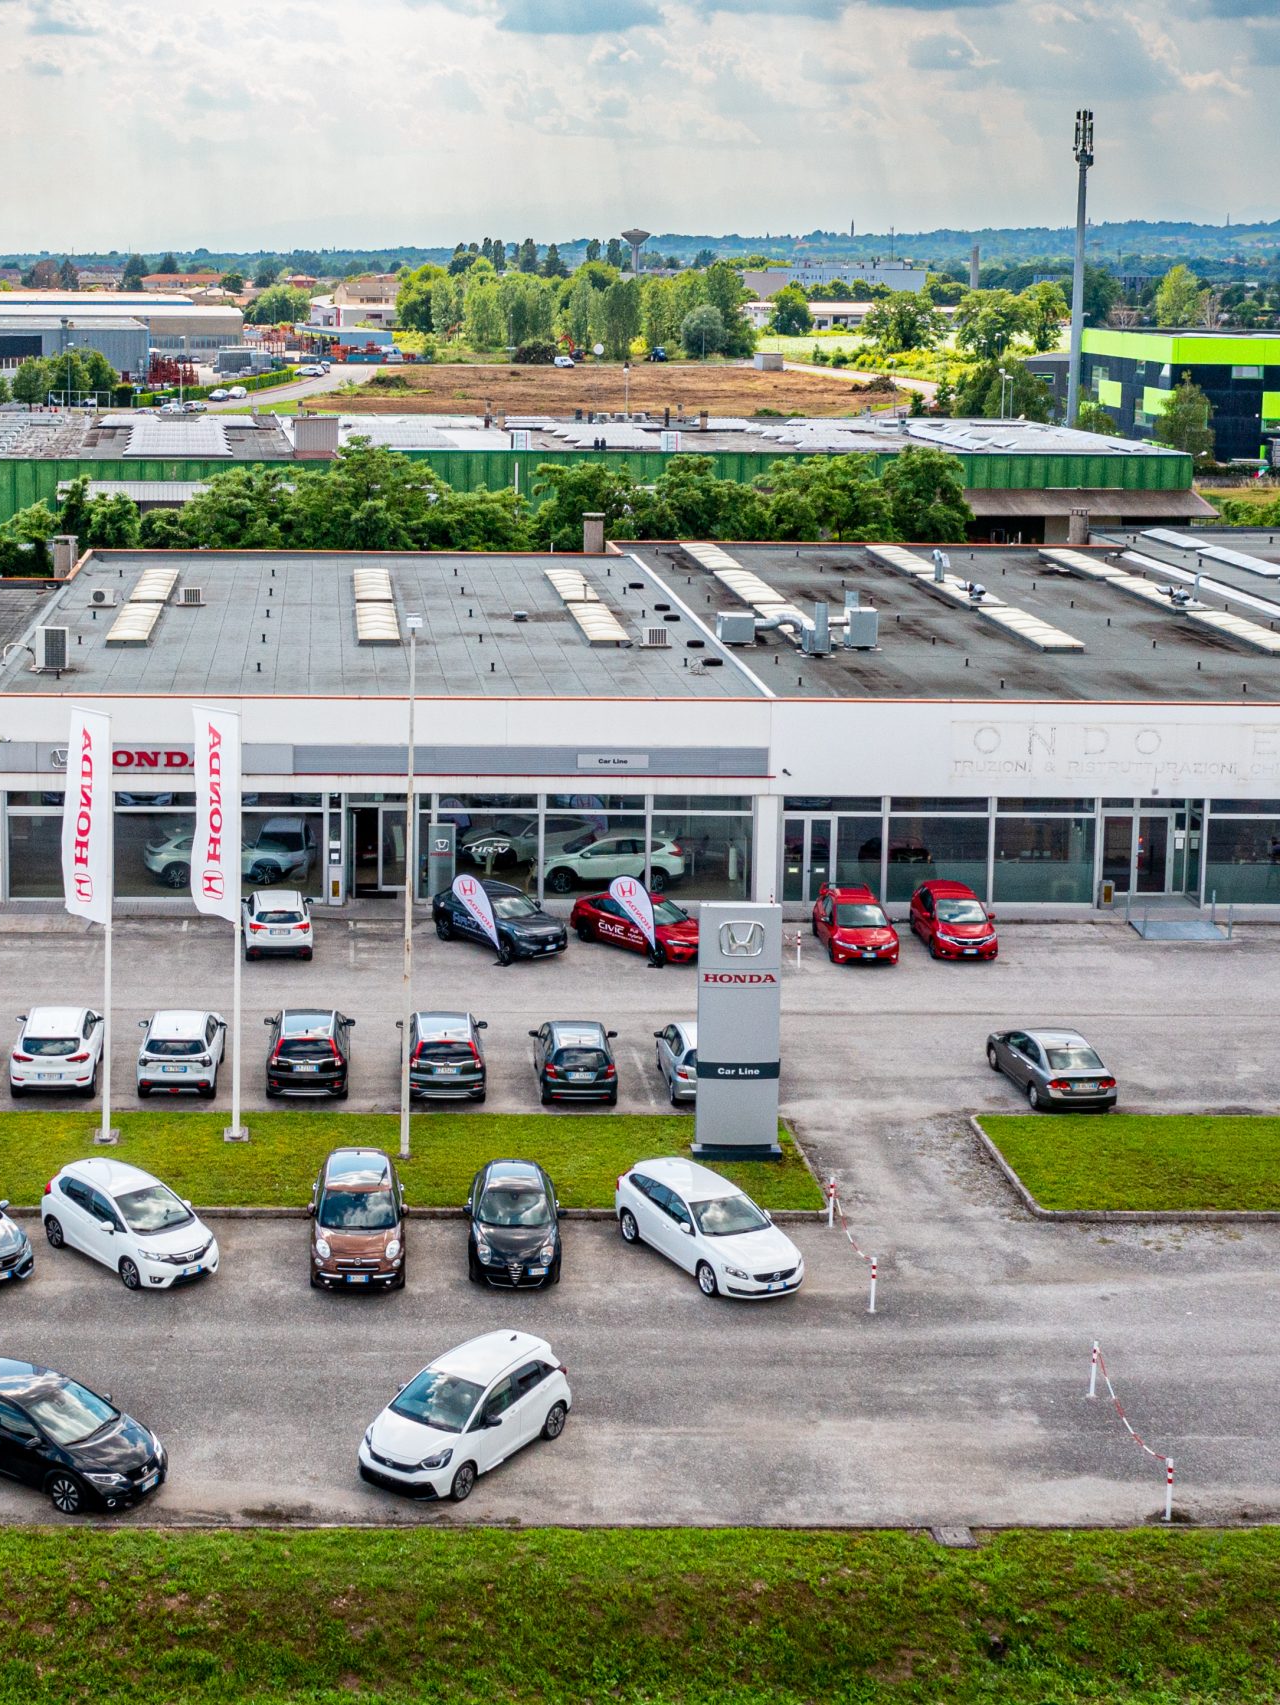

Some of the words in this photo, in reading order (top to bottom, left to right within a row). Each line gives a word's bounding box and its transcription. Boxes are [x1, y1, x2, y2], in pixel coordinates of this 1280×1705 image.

[112, 750, 195, 768] OND
[471, 846, 509, 854] HR-V
[598, 921, 625, 935] CIVIC
[704, 973, 776, 983] HONDA
[717, 1067, 736, 1075] Car
[738, 1067, 760, 1075] Line
